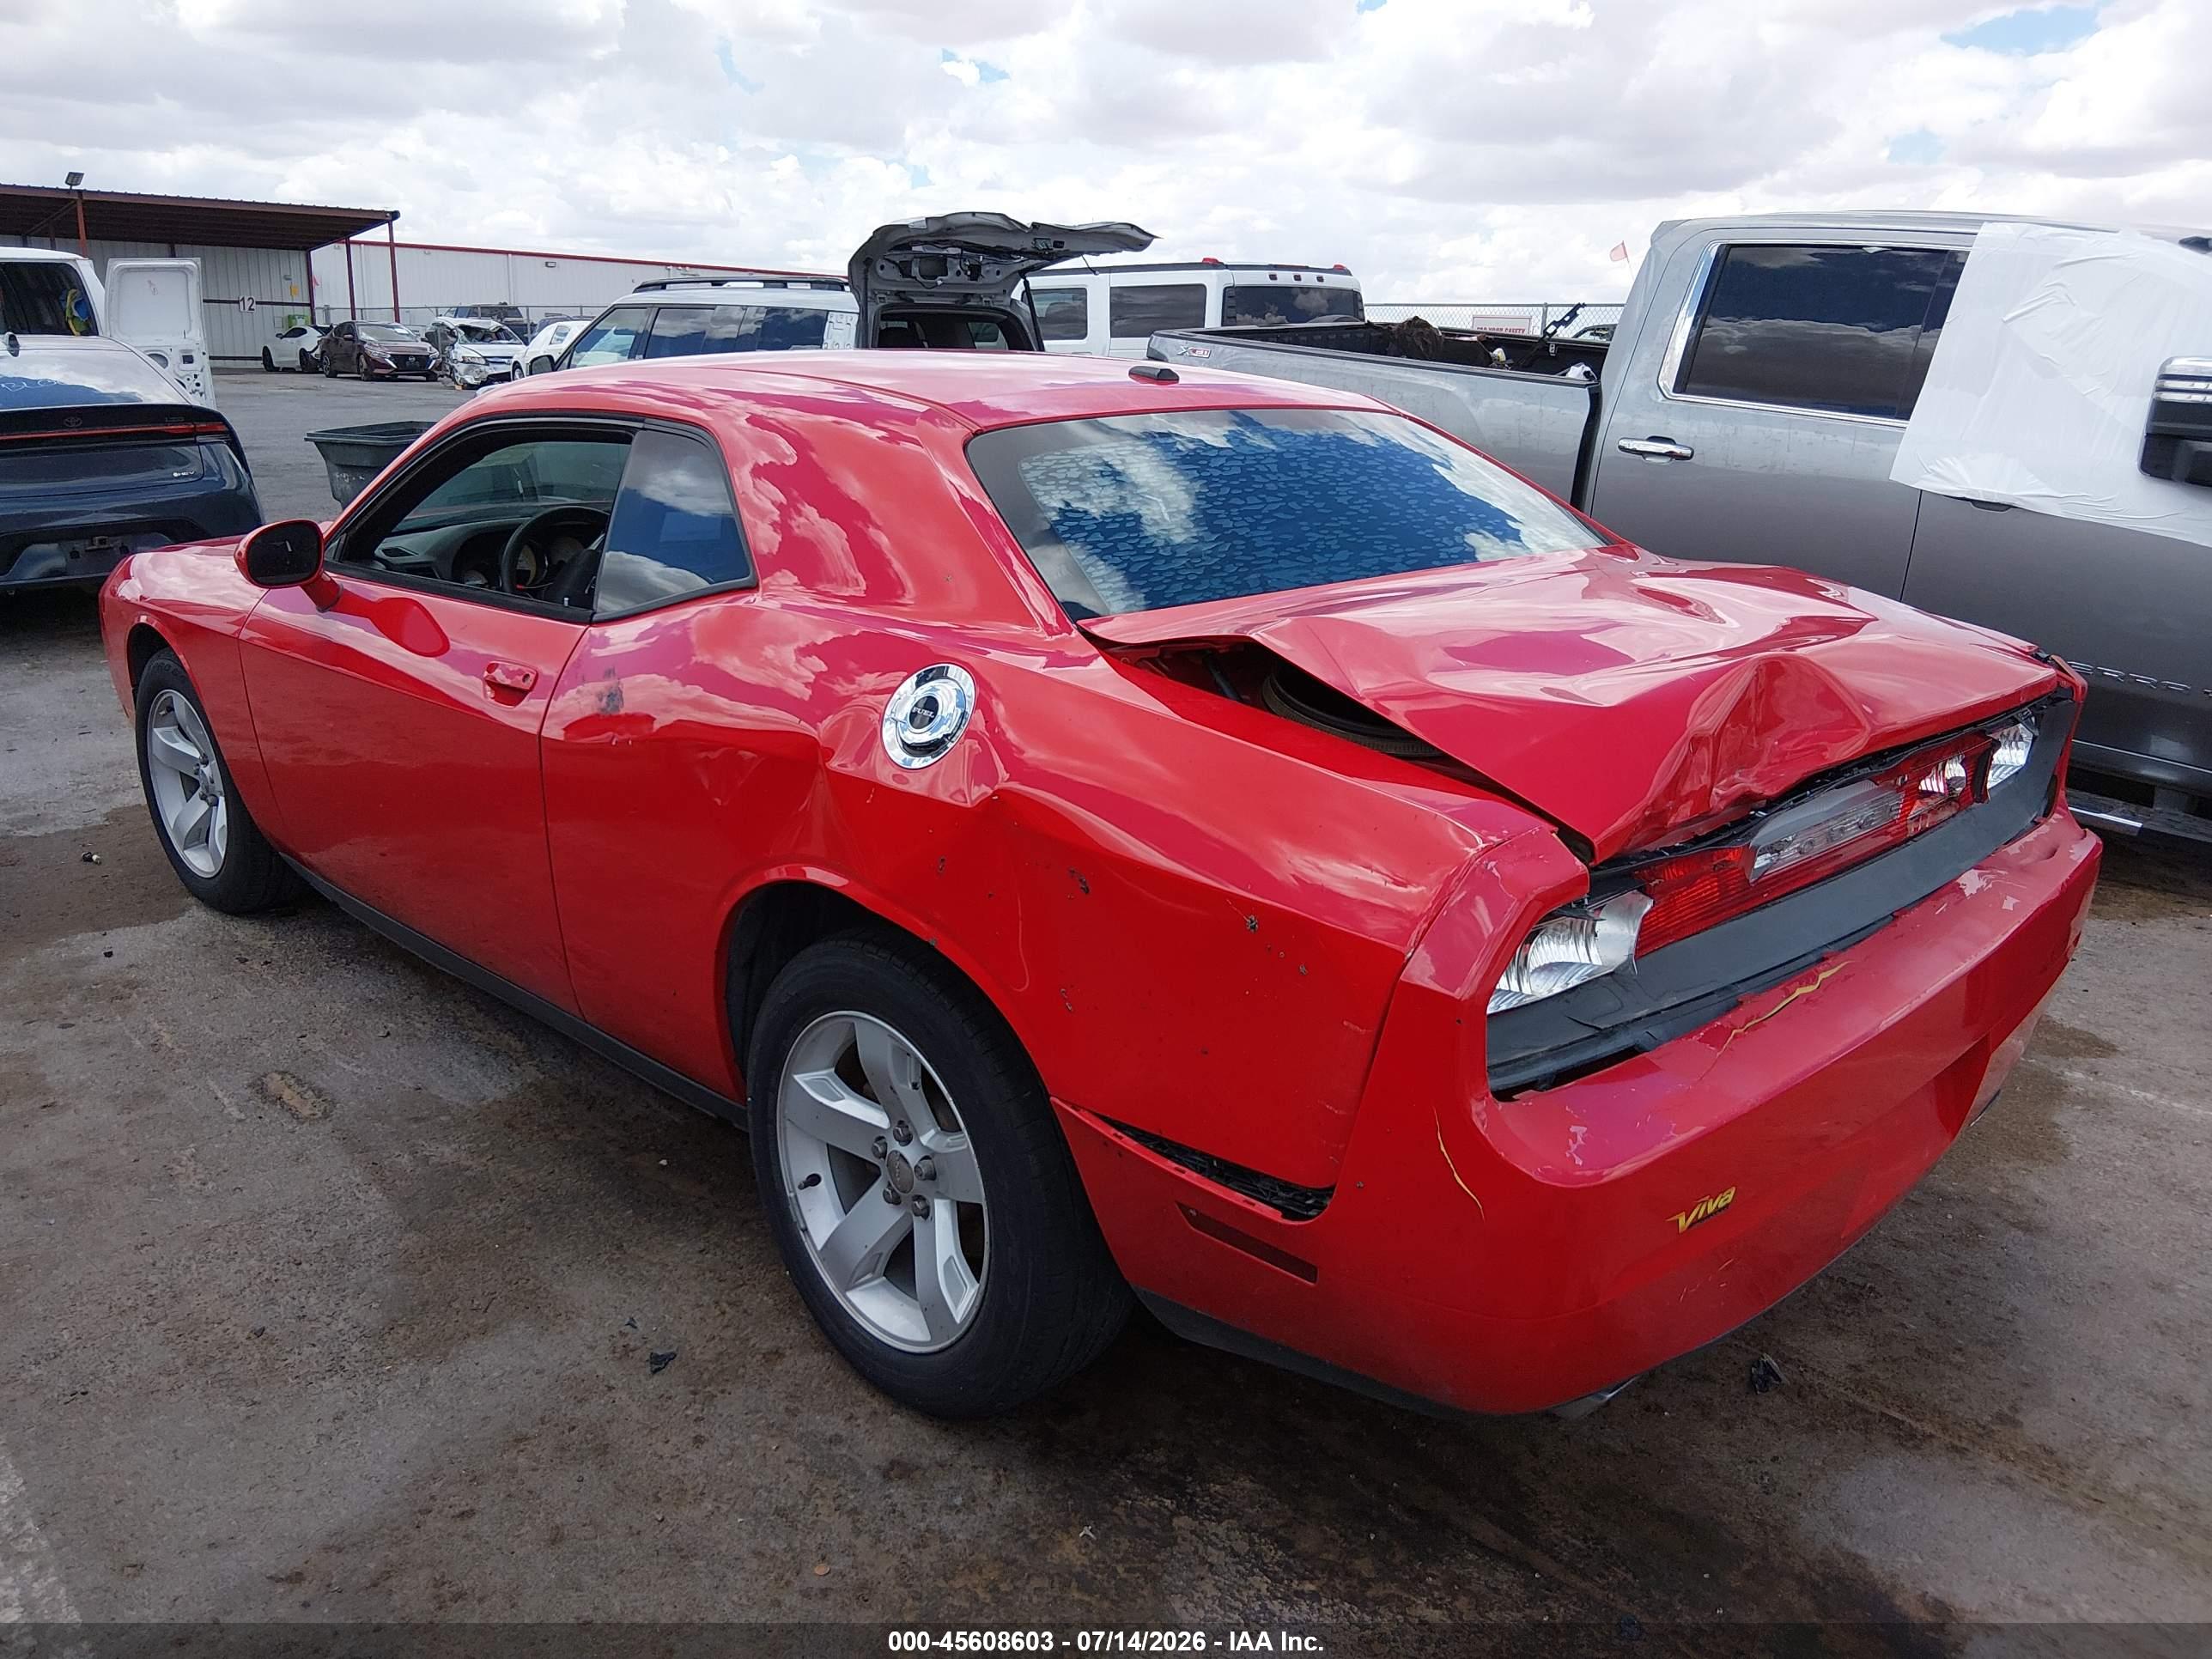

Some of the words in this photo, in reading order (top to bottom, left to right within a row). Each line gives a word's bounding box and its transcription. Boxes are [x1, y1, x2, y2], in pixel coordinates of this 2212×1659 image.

[240, 296, 255, 311] 12
[912, 706, 935, 719] FUEL
[1665, 1186, 1736, 1234] Viva
